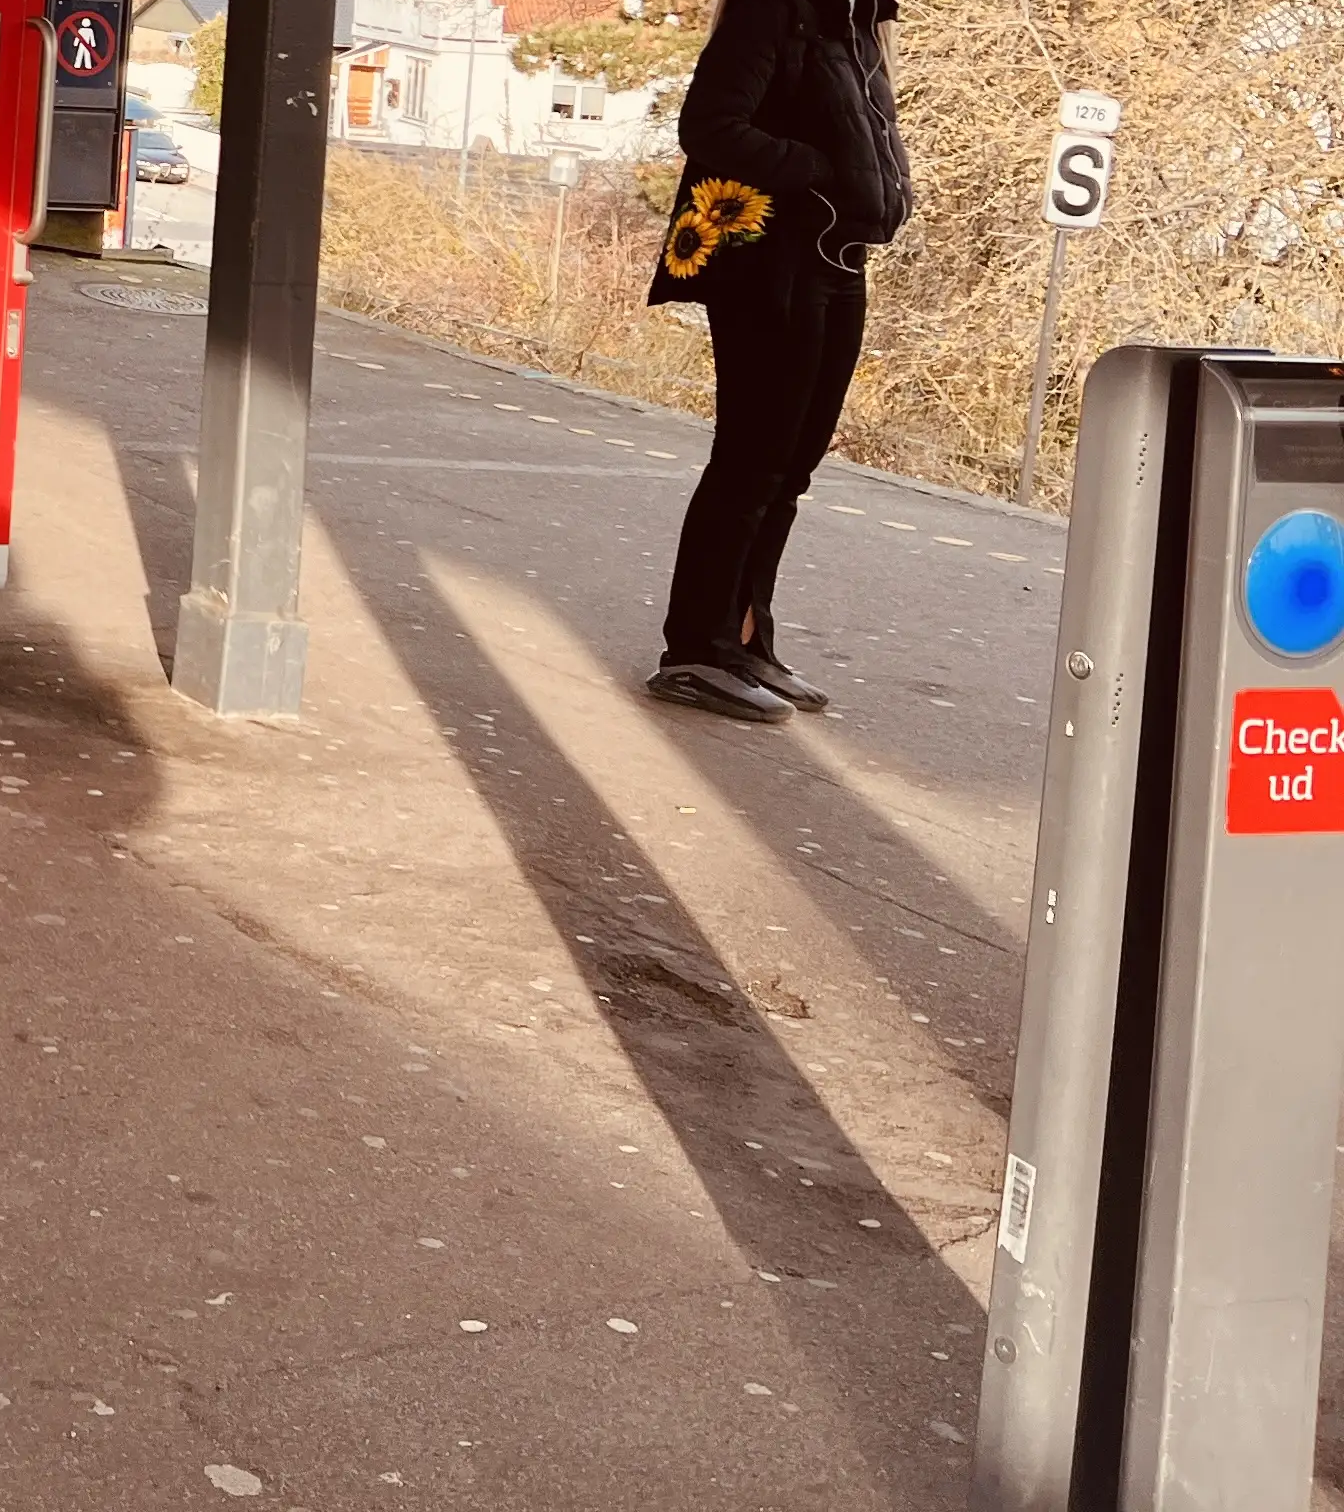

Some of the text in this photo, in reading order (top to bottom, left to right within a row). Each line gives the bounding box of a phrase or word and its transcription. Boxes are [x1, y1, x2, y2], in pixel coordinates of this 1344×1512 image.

[1075, 105, 1107, 122] 1276
[1051, 144, 1105, 217] S
[1238, 717, 1344, 755] Check
[1268, 764, 1314, 801] ud
